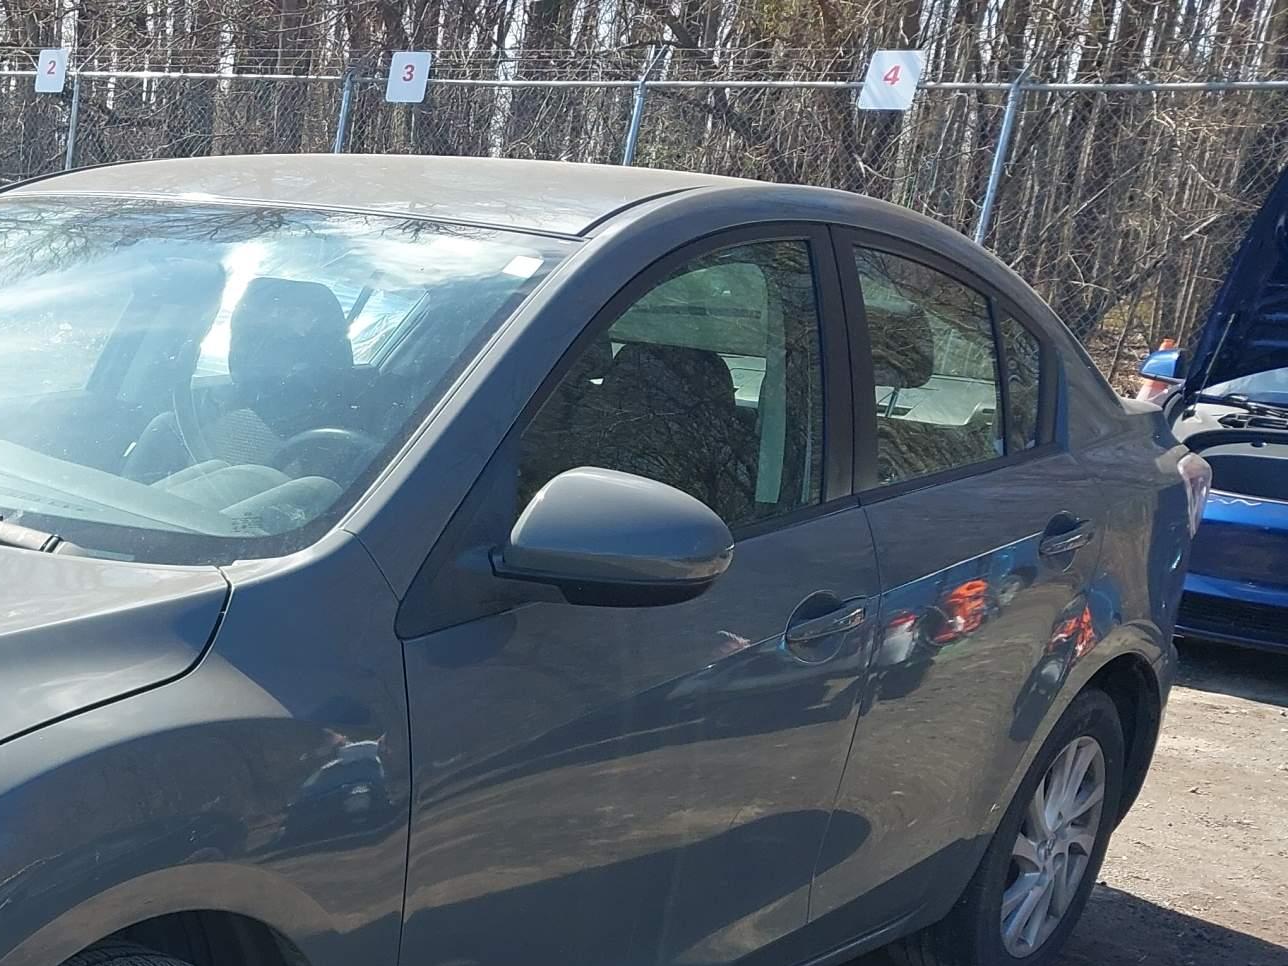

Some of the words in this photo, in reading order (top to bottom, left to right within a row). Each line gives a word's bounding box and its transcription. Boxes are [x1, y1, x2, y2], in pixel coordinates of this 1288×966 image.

[47, 60, 57, 75] 2
[402, 64, 415, 82] 3
[882, 65, 901, 85] 4
